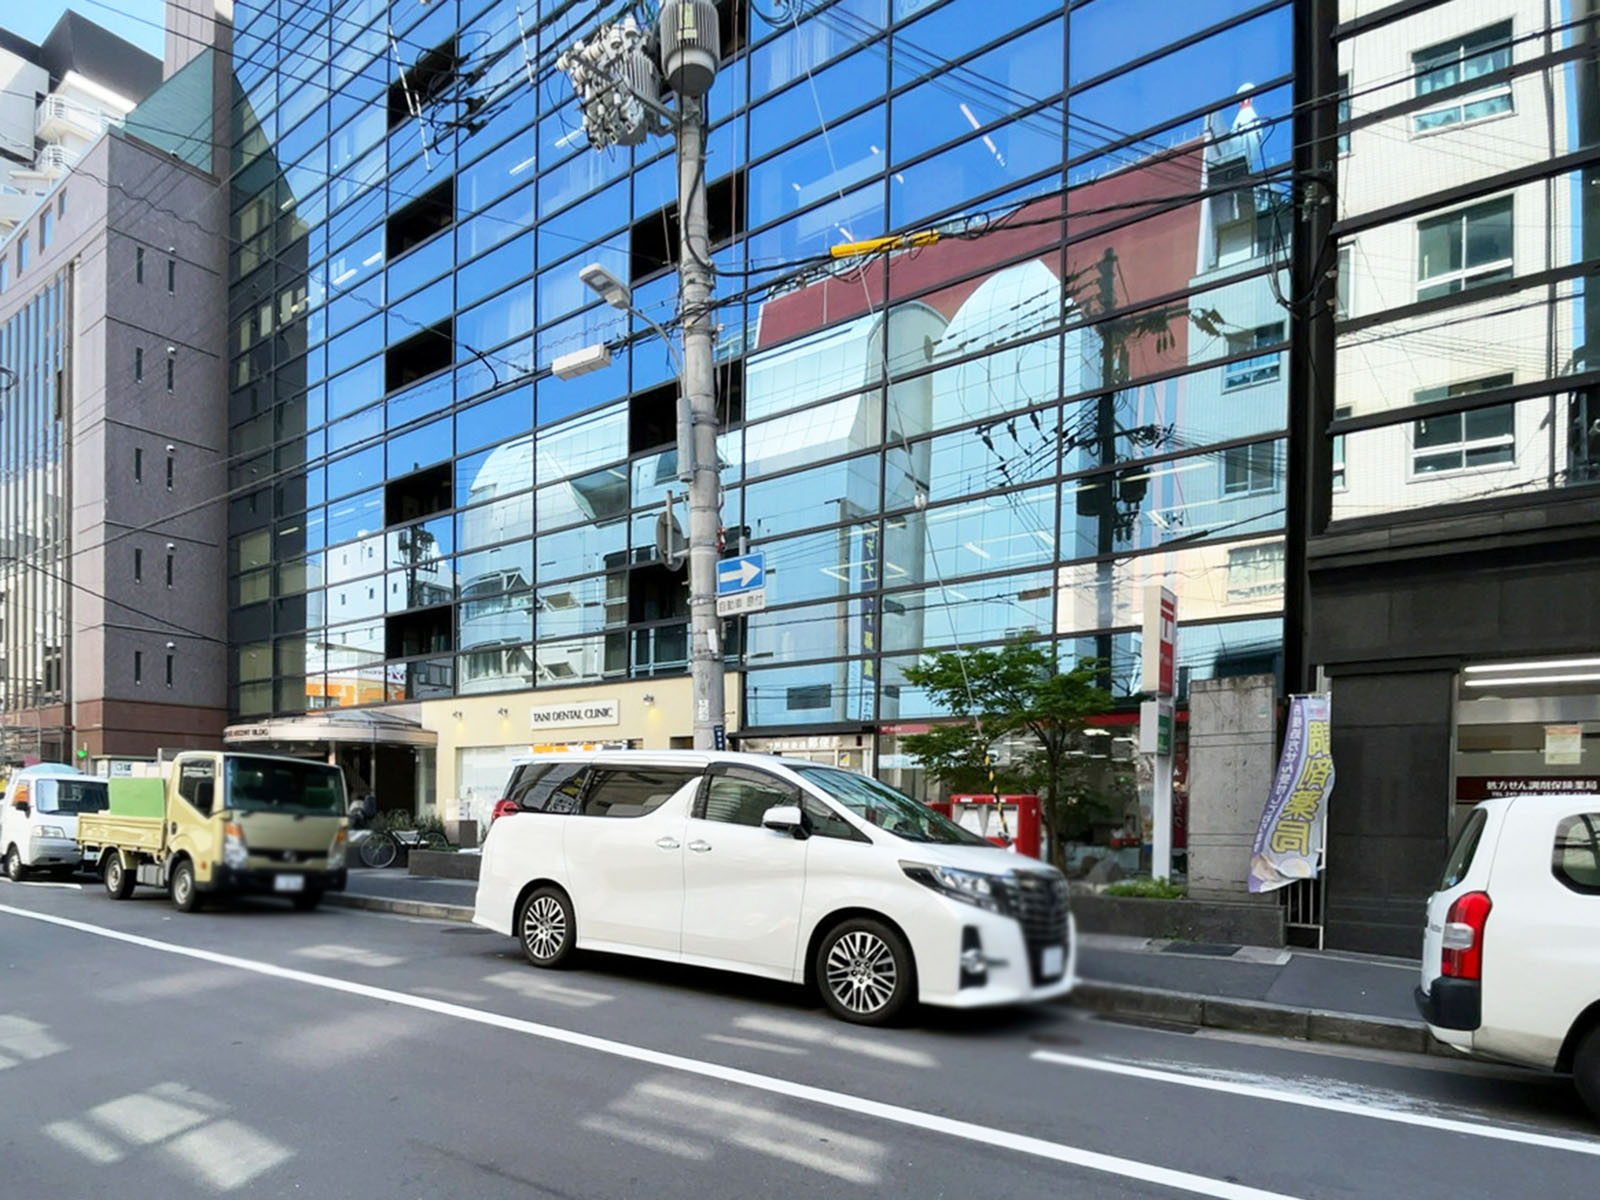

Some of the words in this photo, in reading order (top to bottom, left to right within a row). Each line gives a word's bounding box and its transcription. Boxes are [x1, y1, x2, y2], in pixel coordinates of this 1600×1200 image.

[533, 712, 551, 723] TANI
[552, 709, 583, 722] DENTAL
[584, 707, 613, 719] CLINIC
[1486, 780, 1598, 791] 処方せん調剤保険薬局
